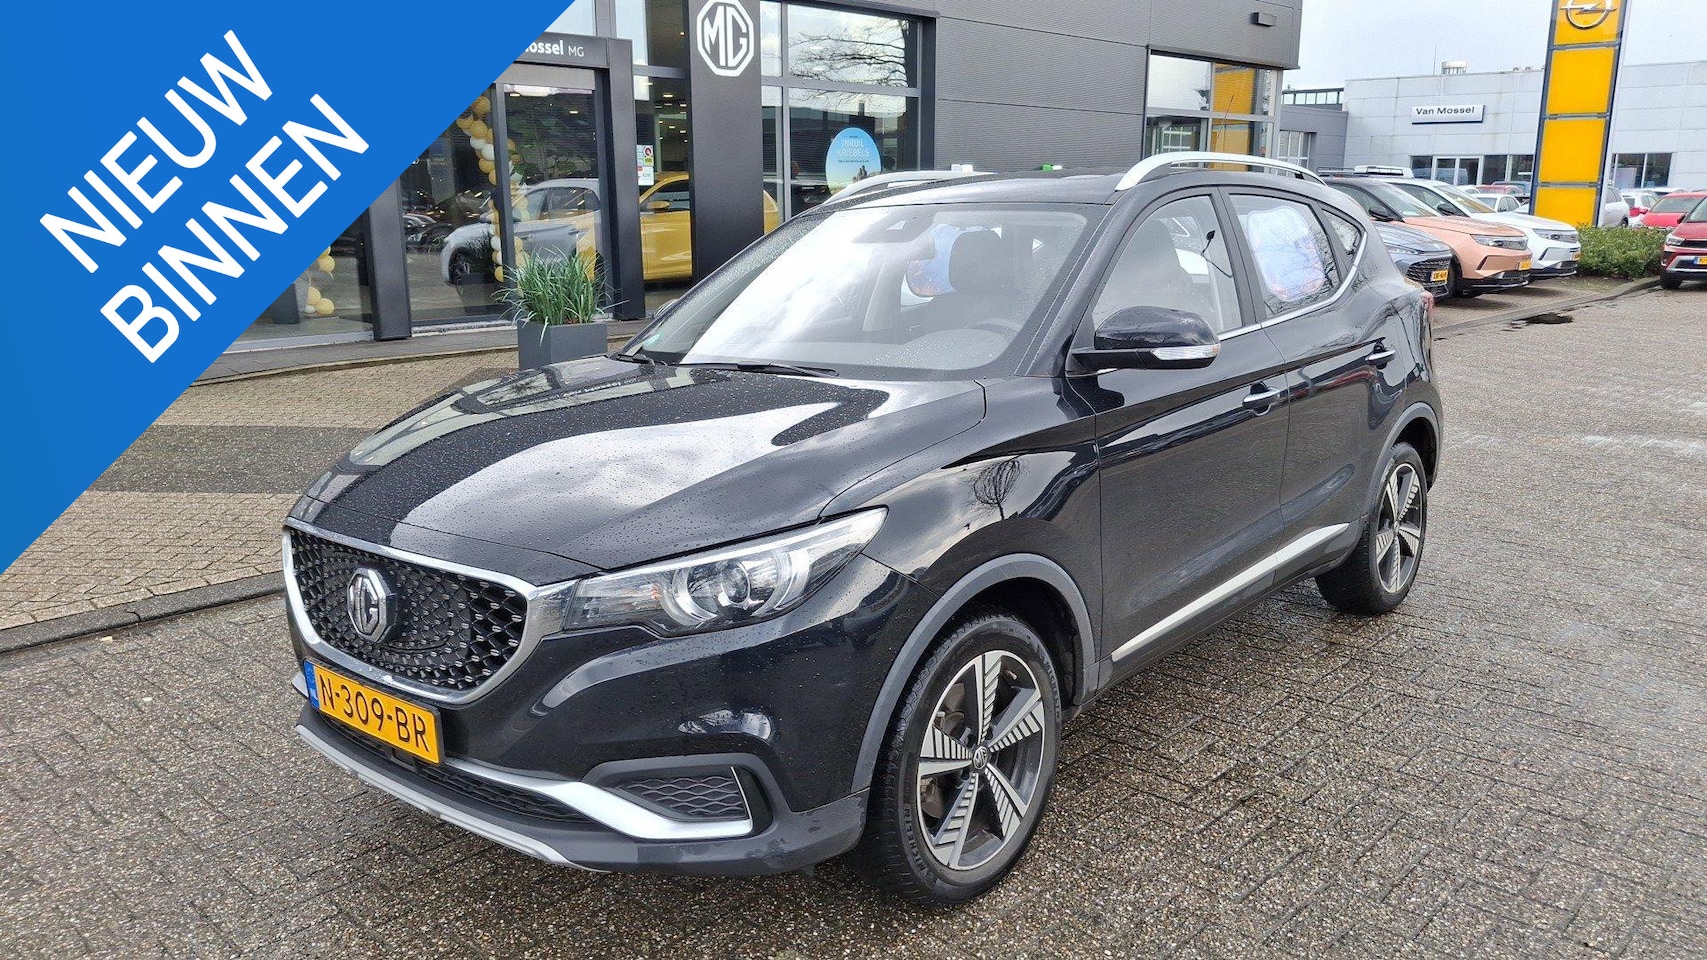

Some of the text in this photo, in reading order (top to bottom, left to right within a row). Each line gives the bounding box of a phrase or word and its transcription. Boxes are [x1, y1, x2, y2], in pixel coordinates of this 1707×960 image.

[525, 40, 585, 57] ossel MG
[703, 5, 748, 67] MG
[1416, 106, 1475, 115] Van Mossel
[319, 674, 430, 752] N-309-BR
